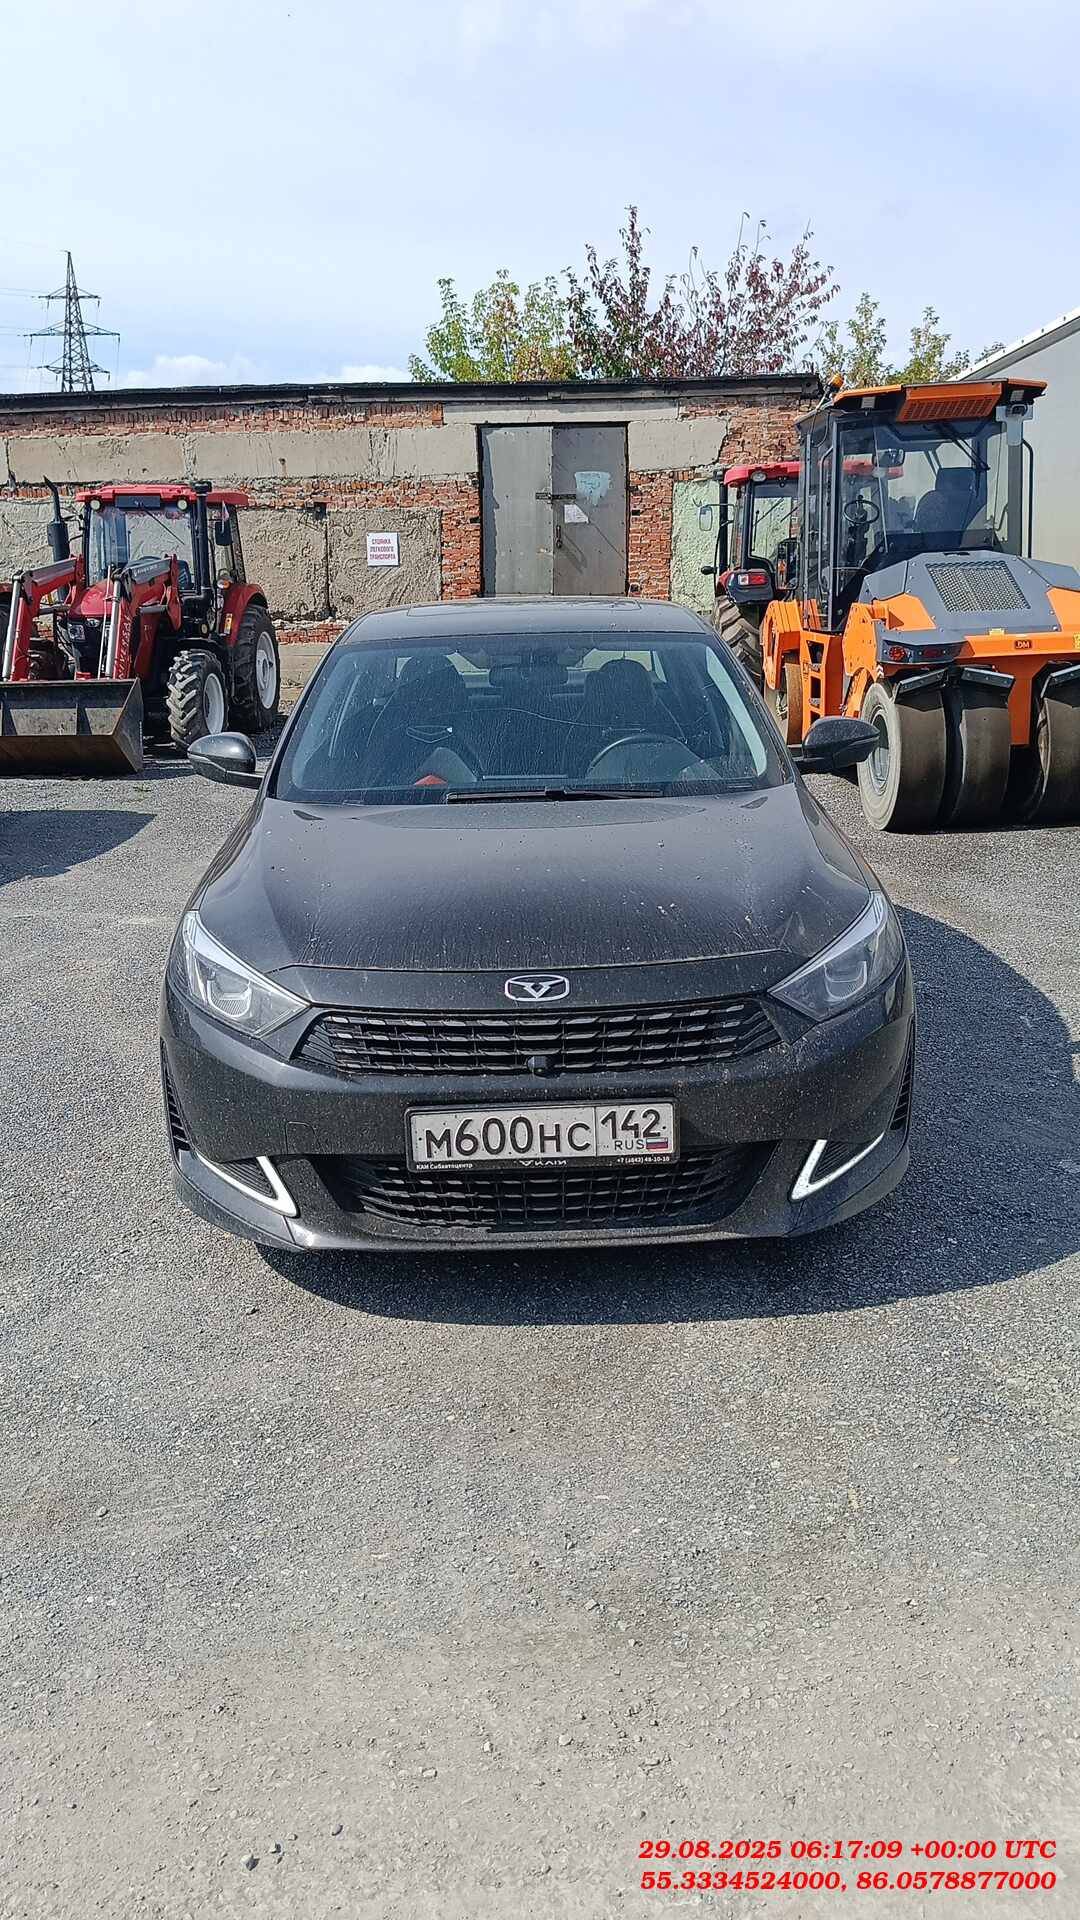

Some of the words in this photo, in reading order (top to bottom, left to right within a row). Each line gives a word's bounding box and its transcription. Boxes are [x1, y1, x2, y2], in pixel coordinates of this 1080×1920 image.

[425, 1116, 591, 1158] М600НС
[601, 1109, 661, 1139] 142
[614, 1139, 645, 1151] RUS
